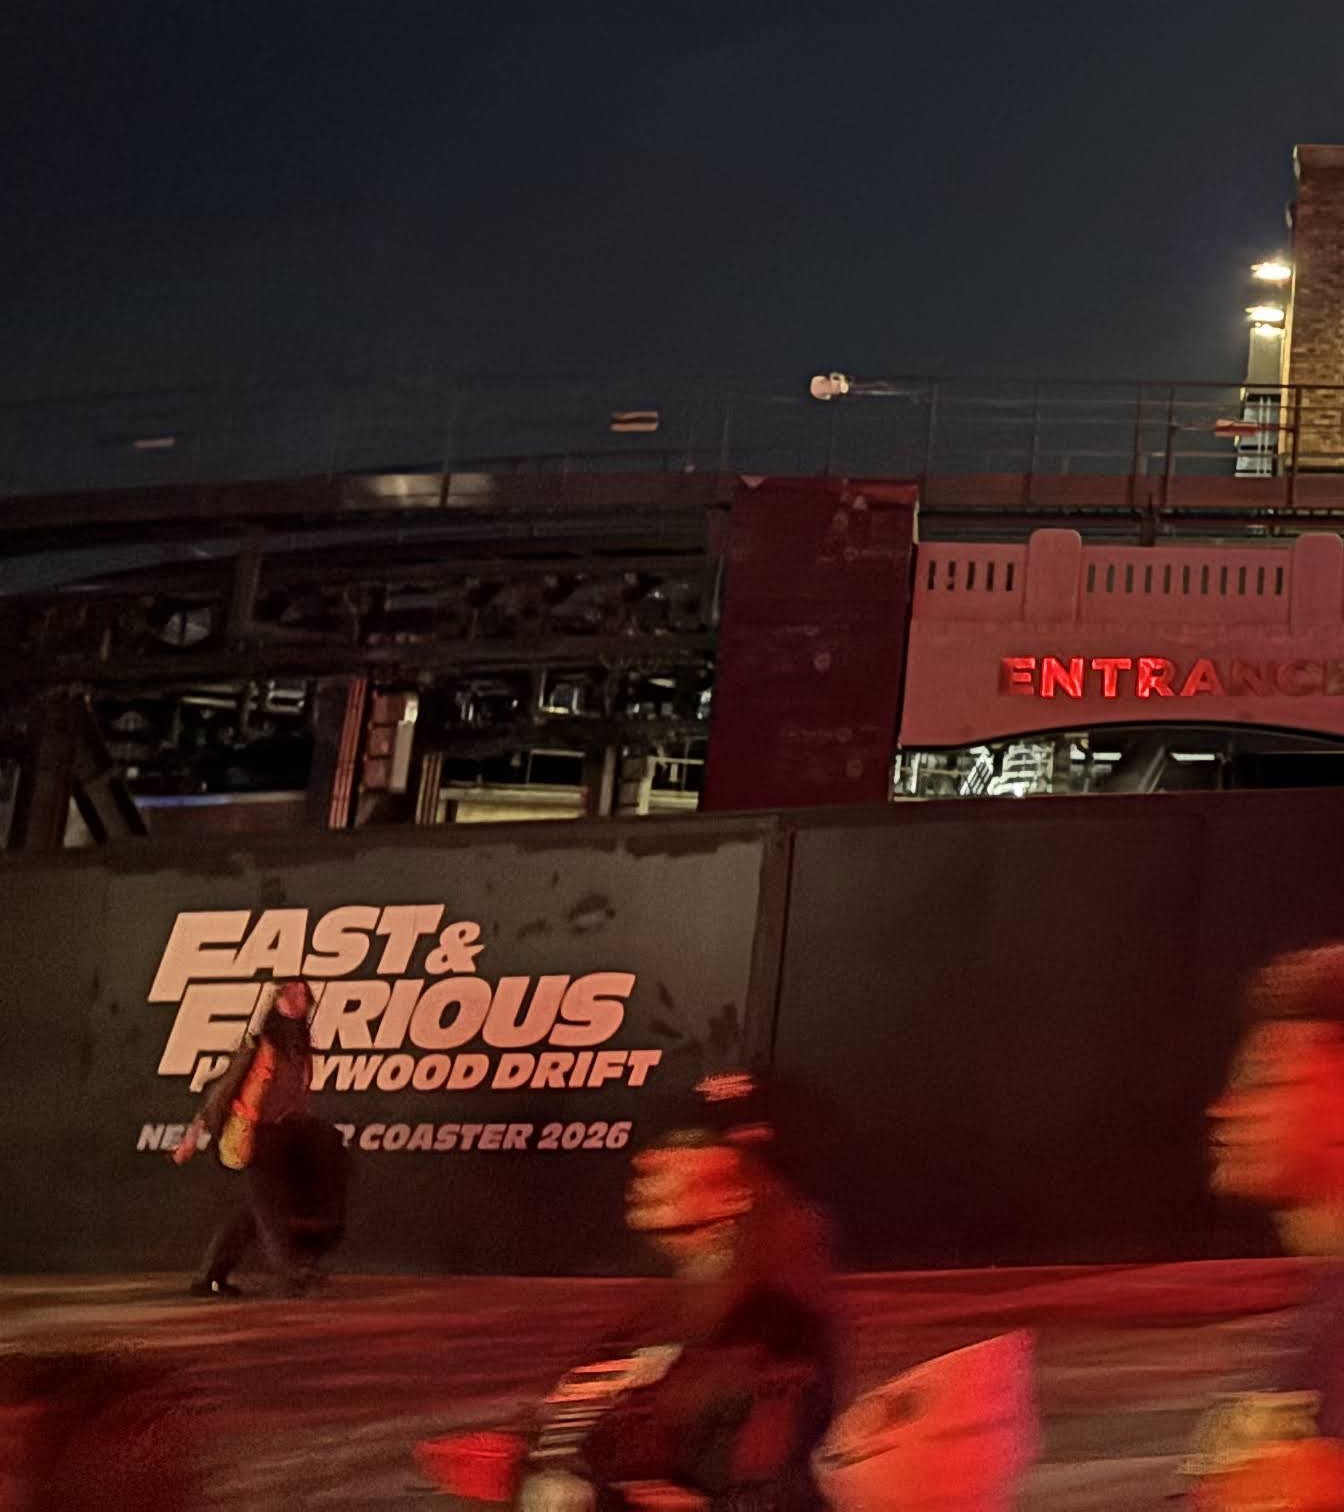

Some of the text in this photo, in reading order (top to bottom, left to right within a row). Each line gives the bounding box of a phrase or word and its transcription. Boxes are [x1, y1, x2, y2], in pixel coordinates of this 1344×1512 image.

[148, 904, 485, 1003] FAST &
[491, 1049, 663, 1088] DRIFT
[358, 1123, 533, 1151] COASTER
[538, 1121, 632, 1150] 2026
